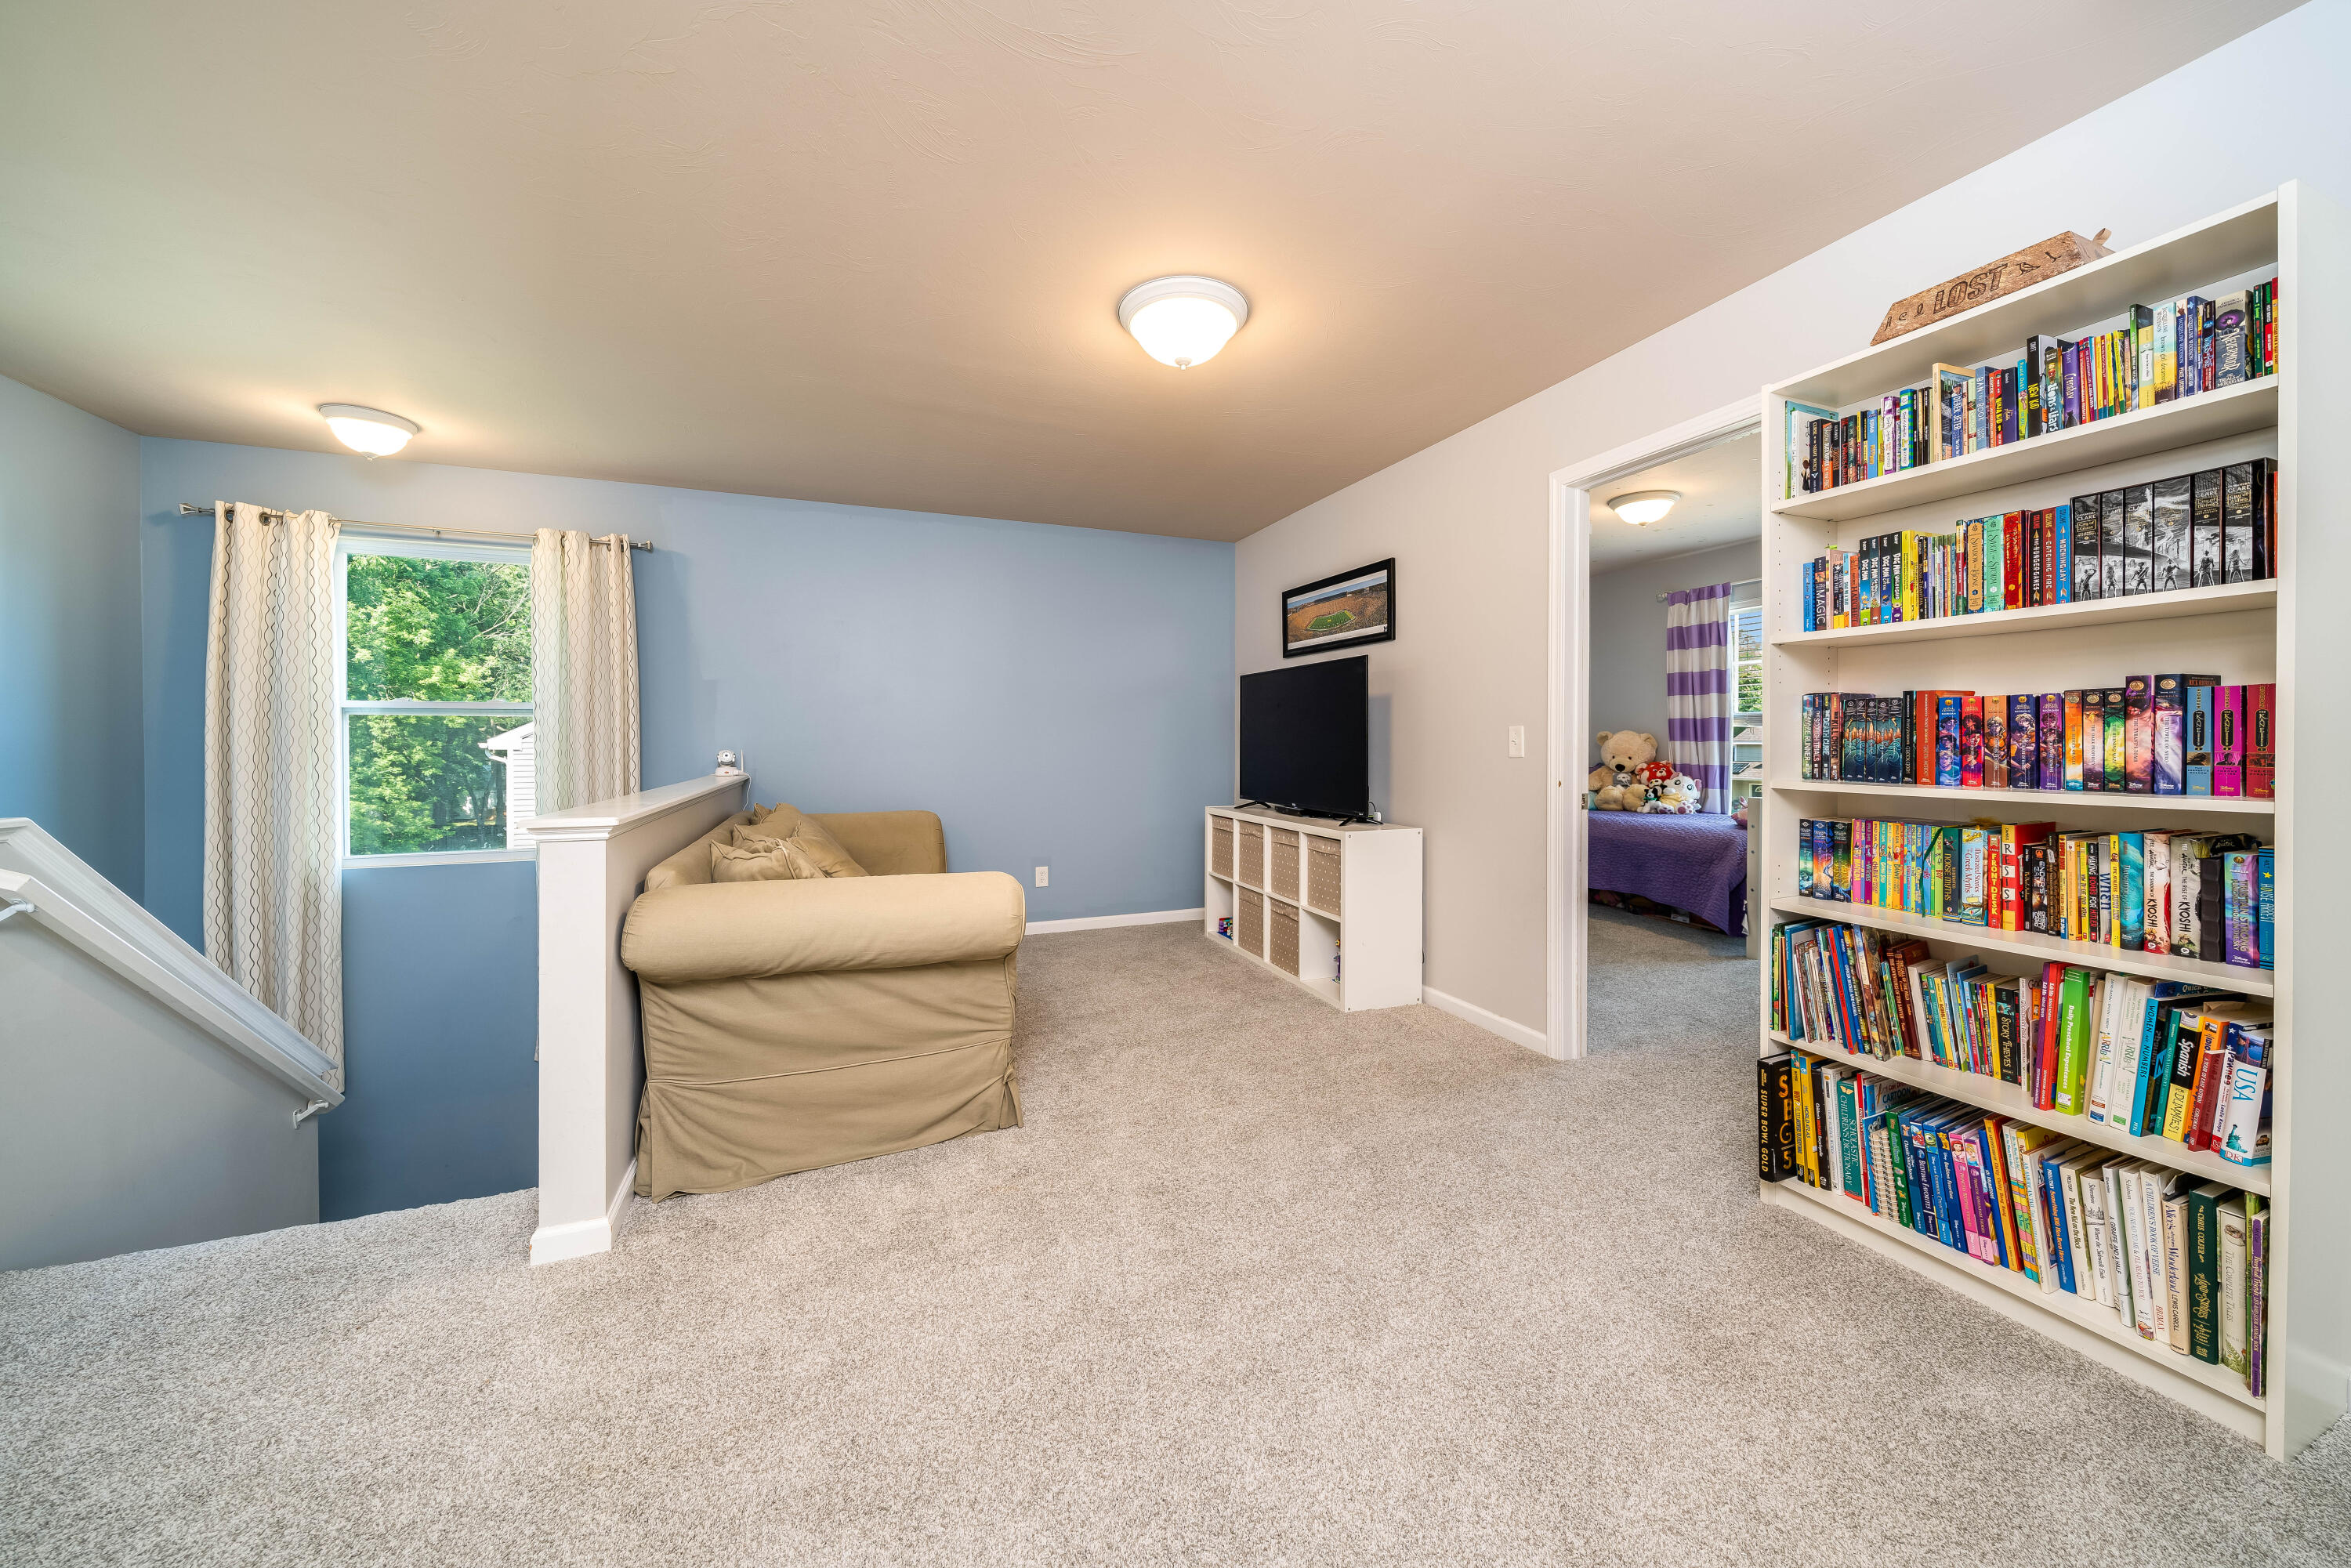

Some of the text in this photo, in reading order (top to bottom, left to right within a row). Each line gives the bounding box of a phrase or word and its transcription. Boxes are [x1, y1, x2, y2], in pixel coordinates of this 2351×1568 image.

[1933, 263, 2008, 314] LOST
[2219, 328, 2241, 375] NEVERMOOR
[2028, 383, 2040, 410] NEW KID
[2064, 373, 2077, 399] Crenshaw
[1953, 415, 1962, 430] JETER
[2047, 383, 2059, 432] Lions Liars
[1882, 556, 1890, 566] DOG
[1893, 552, 1901, 563] DOG
[1893, 563, 1901, 575] MAN
[1988, 560, 1998, 585] STORM
[1817, 588, 1825, 625] MAGIC
[1963, 873, 1972, 893] Myths
[2004, 844, 2012, 911] RESIST
[2147, 899, 2157, 928] KYOSHI
[2178, 901, 2190, 932] KYOSHI
[2239, 880, 2249, 952] TRISTAN STRONG
[2260, 883, 2275, 923] HOUSE ARREST
[2001, 1017, 2012, 1067] STORY THIEVES
[2065, 1021, 2074, 1052] Preschool
[2139, 1005, 2155, 1078] WOMEN NUMBERS
[2063, 1052, 2071, 1089] Experiences
[2177, 1038, 2194, 1077] Spanish
[1882, 1087, 1911, 1104] CARTOON
[2233, 1068, 2258, 1101] USA
[1840, 1095, 1853, 1185] CHILDREN'S DICTIONARY
[1849, 1119, 1859, 1166] SCHOLASTIC
[2226, 1151, 2242, 1162] DK
[2046, 1169, 2055, 1190] PRELUTSKY
[1922, 1182, 1931, 1209] FAVORITES
[2049, 1190, 2058, 1216] Something
[2146, 1187, 2156, 1226] CHILDREN'S
[2165, 1205, 2177, 1229] Alice's
[2150, 1226, 2158, 1245] BOOK
[2167, 1247, 2180, 1293] Wonderland
[2226, 1251, 2234, 1322] THE COMPLETE TALES
[2156, 1305, 2164, 1331] BRIMAX
[2193, 1294, 2211, 1319] STORIES
